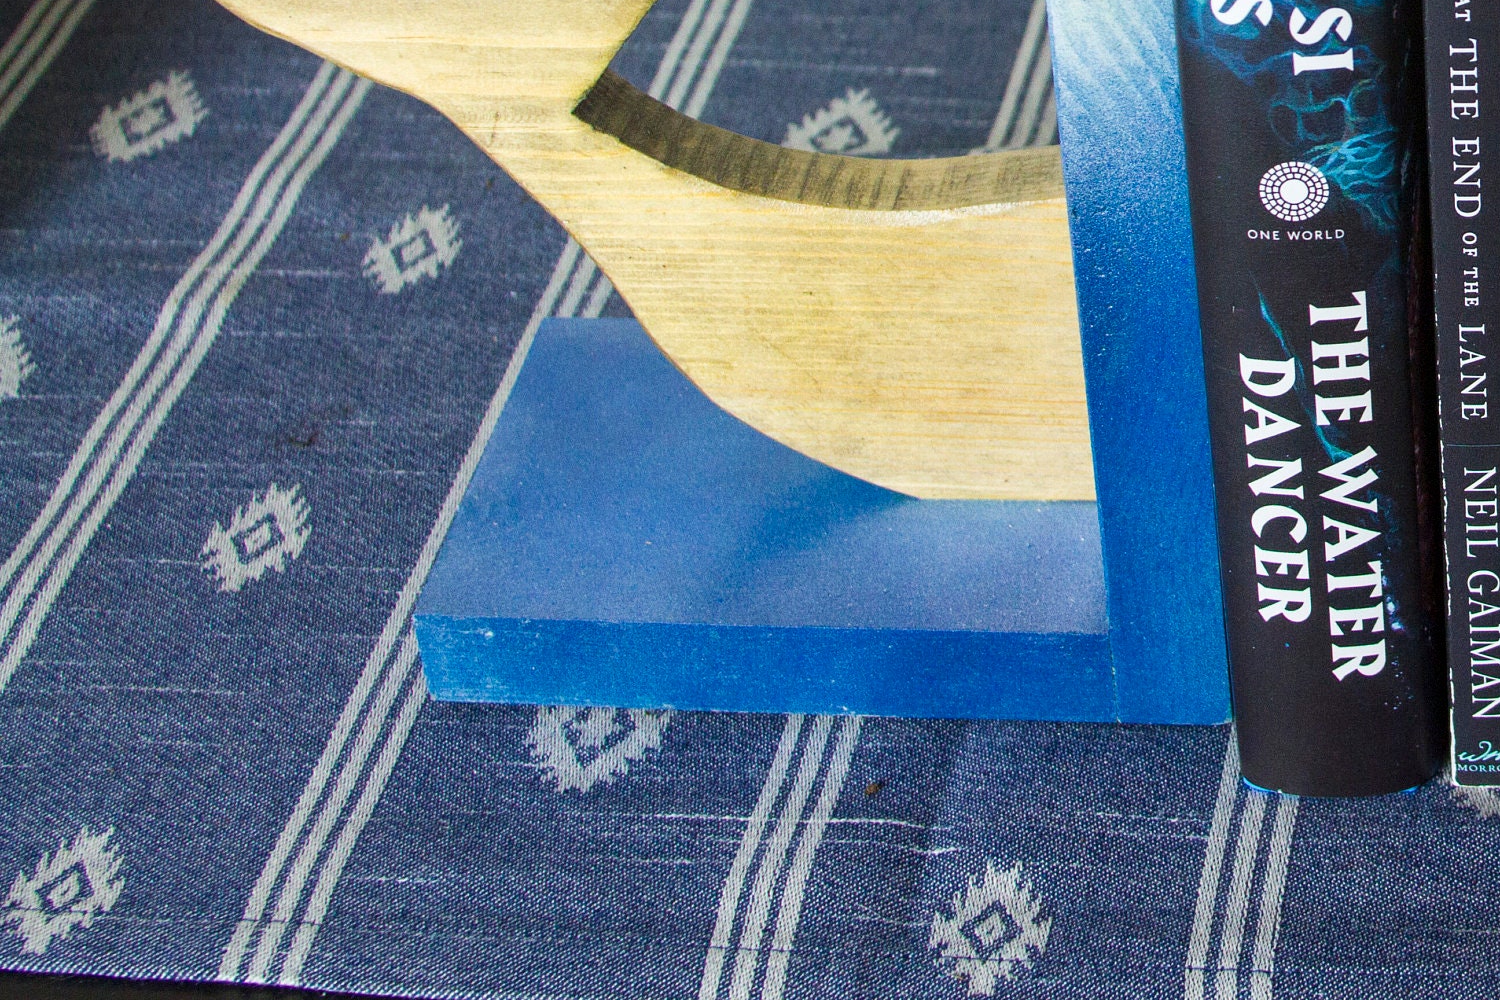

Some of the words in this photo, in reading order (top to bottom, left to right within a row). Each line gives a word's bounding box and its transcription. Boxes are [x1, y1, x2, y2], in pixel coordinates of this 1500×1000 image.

[1448, 38, 1479, 121] THE
[1452, 135, 1482, 219] END
[1247, 229, 1281, 241] ONE
[1286, 228, 1346, 241] WORLD
[1461, 231, 1479, 259] OF
[1463, 267, 1480, 308] THE
[1308, 290, 1373, 427] THE
[1457, 323, 1488, 421] LANE
[1238, 352, 1313, 623] DANCER
[1463, 465, 1498, 559] NEIL
[1317, 444, 1387, 683] WATER
